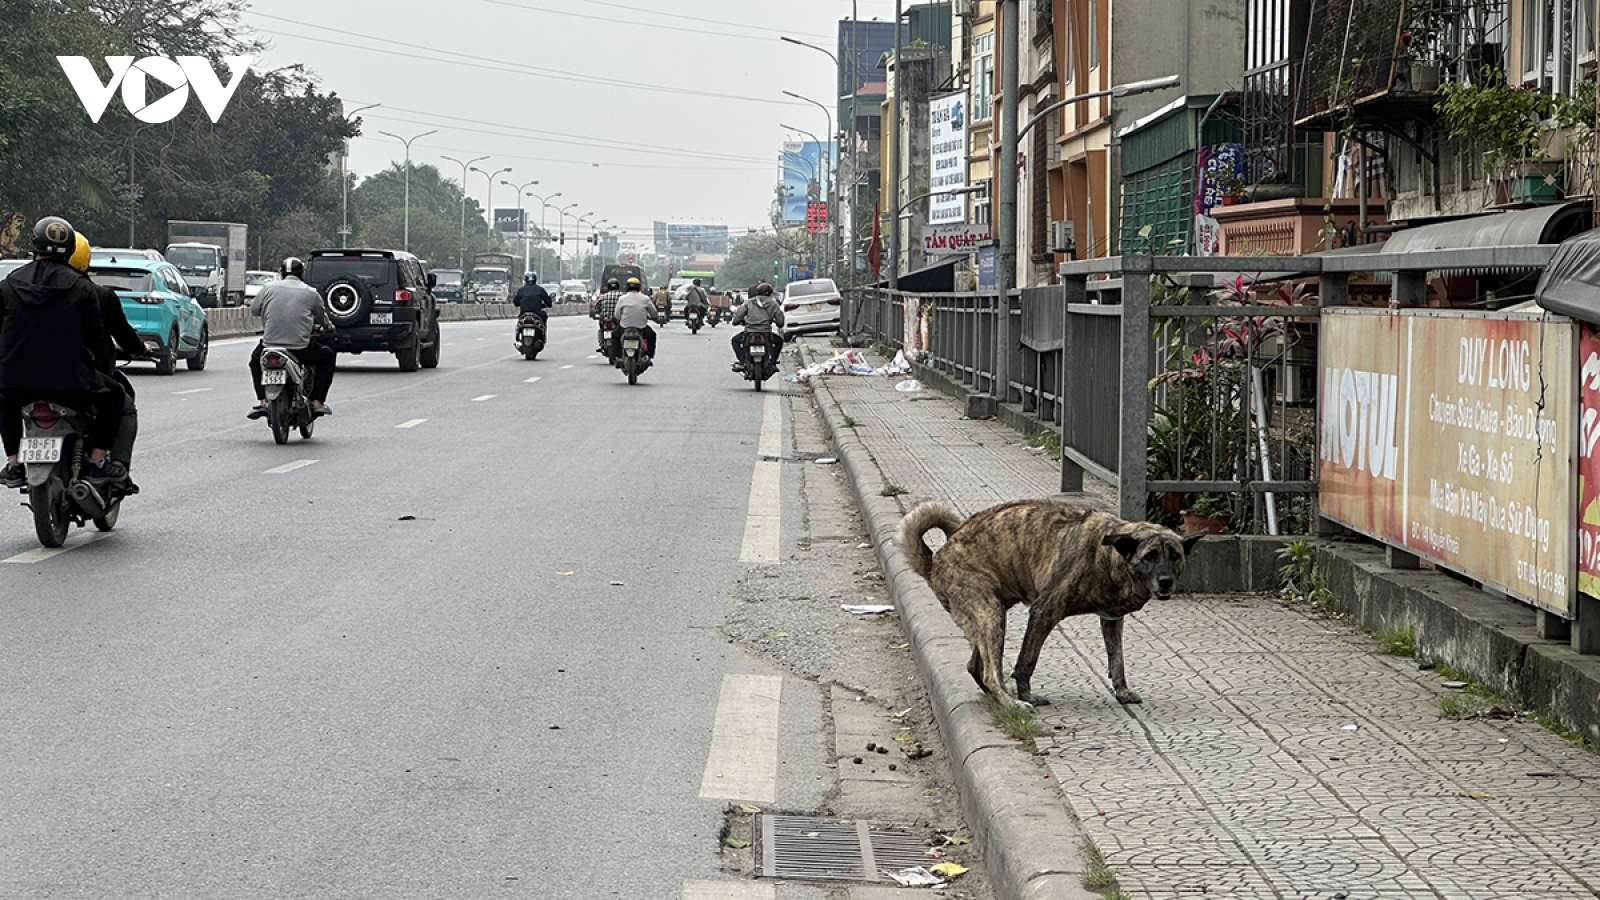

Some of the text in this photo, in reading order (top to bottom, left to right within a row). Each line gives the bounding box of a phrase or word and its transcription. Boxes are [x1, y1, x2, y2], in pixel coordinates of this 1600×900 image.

[1458, 336, 1487, 387] DUY
[1488, 338, 1530, 392] LONG
[1320, 367, 1398, 479] MOTUL
[1458, 396, 1474, 429] Sửa
[1474, 400, 1498, 434] Chữa
[1505, 404, 1525, 440] Bảo
[27, 439, 56, 449] 18-F1
[1457, 442, 1467, 473] Xe
[1468, 445, 1480, 477] Ga
[1486, 447, 1497, 480] Xe
[1499, 446, 1513, 484] Số
[1430, 478, 1444, 509] Mua
[1460, 487, 1470, 518] Xe
[1471, 490, 1488, 532] Máy
[1489, 495, 1506, 531] Qua
[1508, 501, 1523, 535] Sử
[1524, 505, 1550, 553] Dụng
